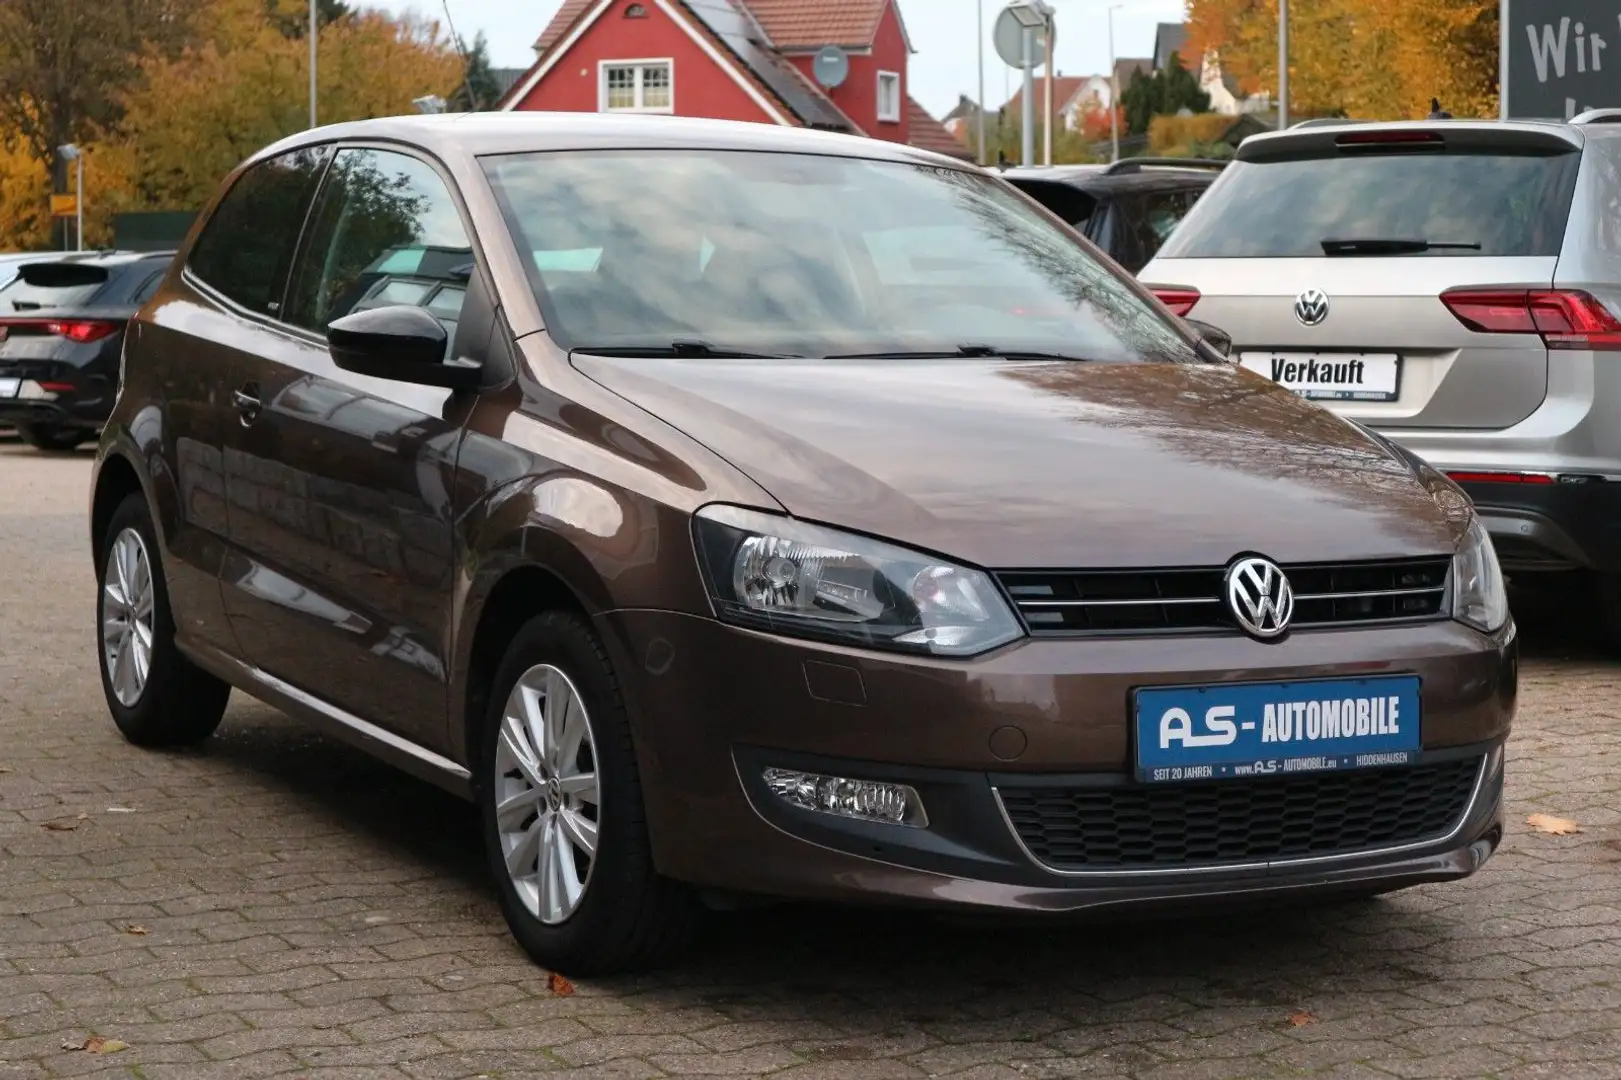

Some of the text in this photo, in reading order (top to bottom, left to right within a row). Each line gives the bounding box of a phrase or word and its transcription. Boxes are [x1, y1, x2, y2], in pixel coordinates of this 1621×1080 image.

[1525, 16, 1607, 83] Wir
[1271, 358, 1364, 384] Verkauft
[1230, 559, 1292, 635] VW
[1153, 767, 1171, 781] SEIT
[1171, 766, 1182, 779] 20
[1183, 765, 1213, 779] JAHREN
[1356, 752, 1408, 766] HIDDENHAUSEN
